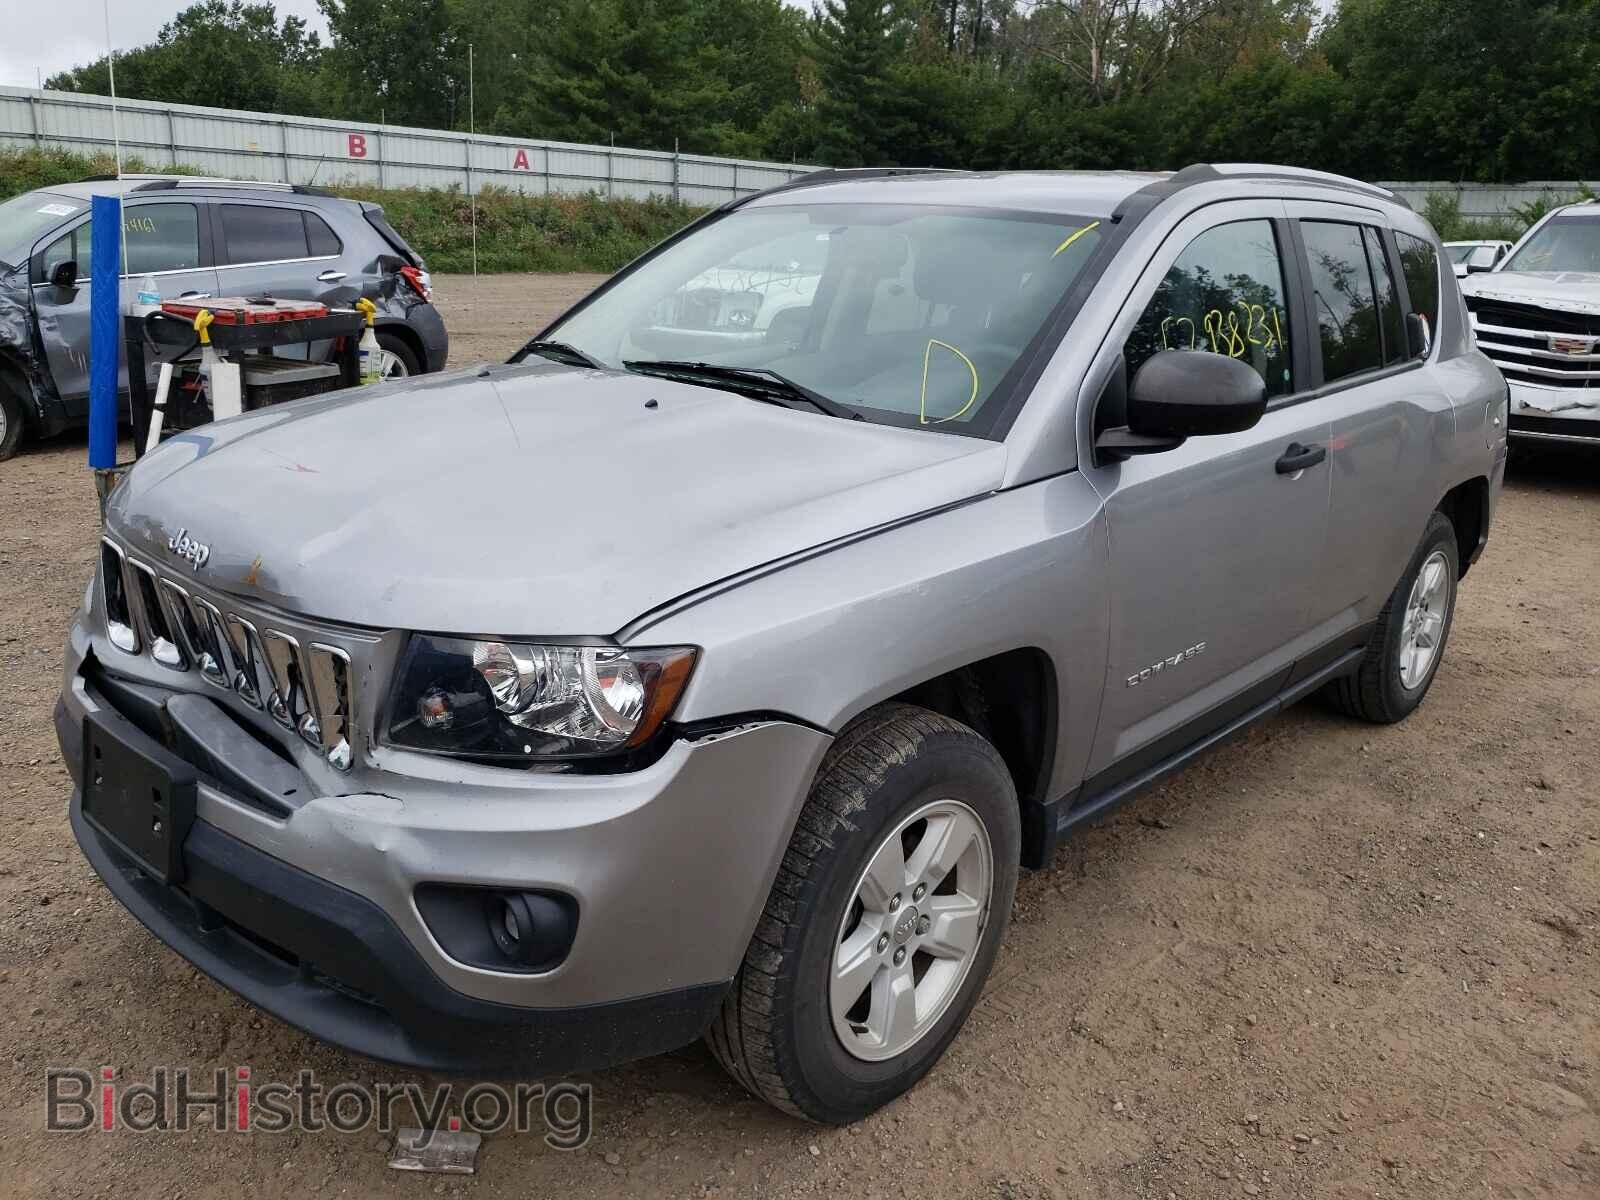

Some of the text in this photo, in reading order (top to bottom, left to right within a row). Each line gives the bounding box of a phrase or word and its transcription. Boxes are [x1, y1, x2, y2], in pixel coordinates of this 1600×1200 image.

[348, 134, 367, 158] B
[513, 148, 530, 170] A
[920, 338, 978, 424] D
[168, 527, 210, 571] Jeep
[1126, 640, 1207, 688] COMPASS
